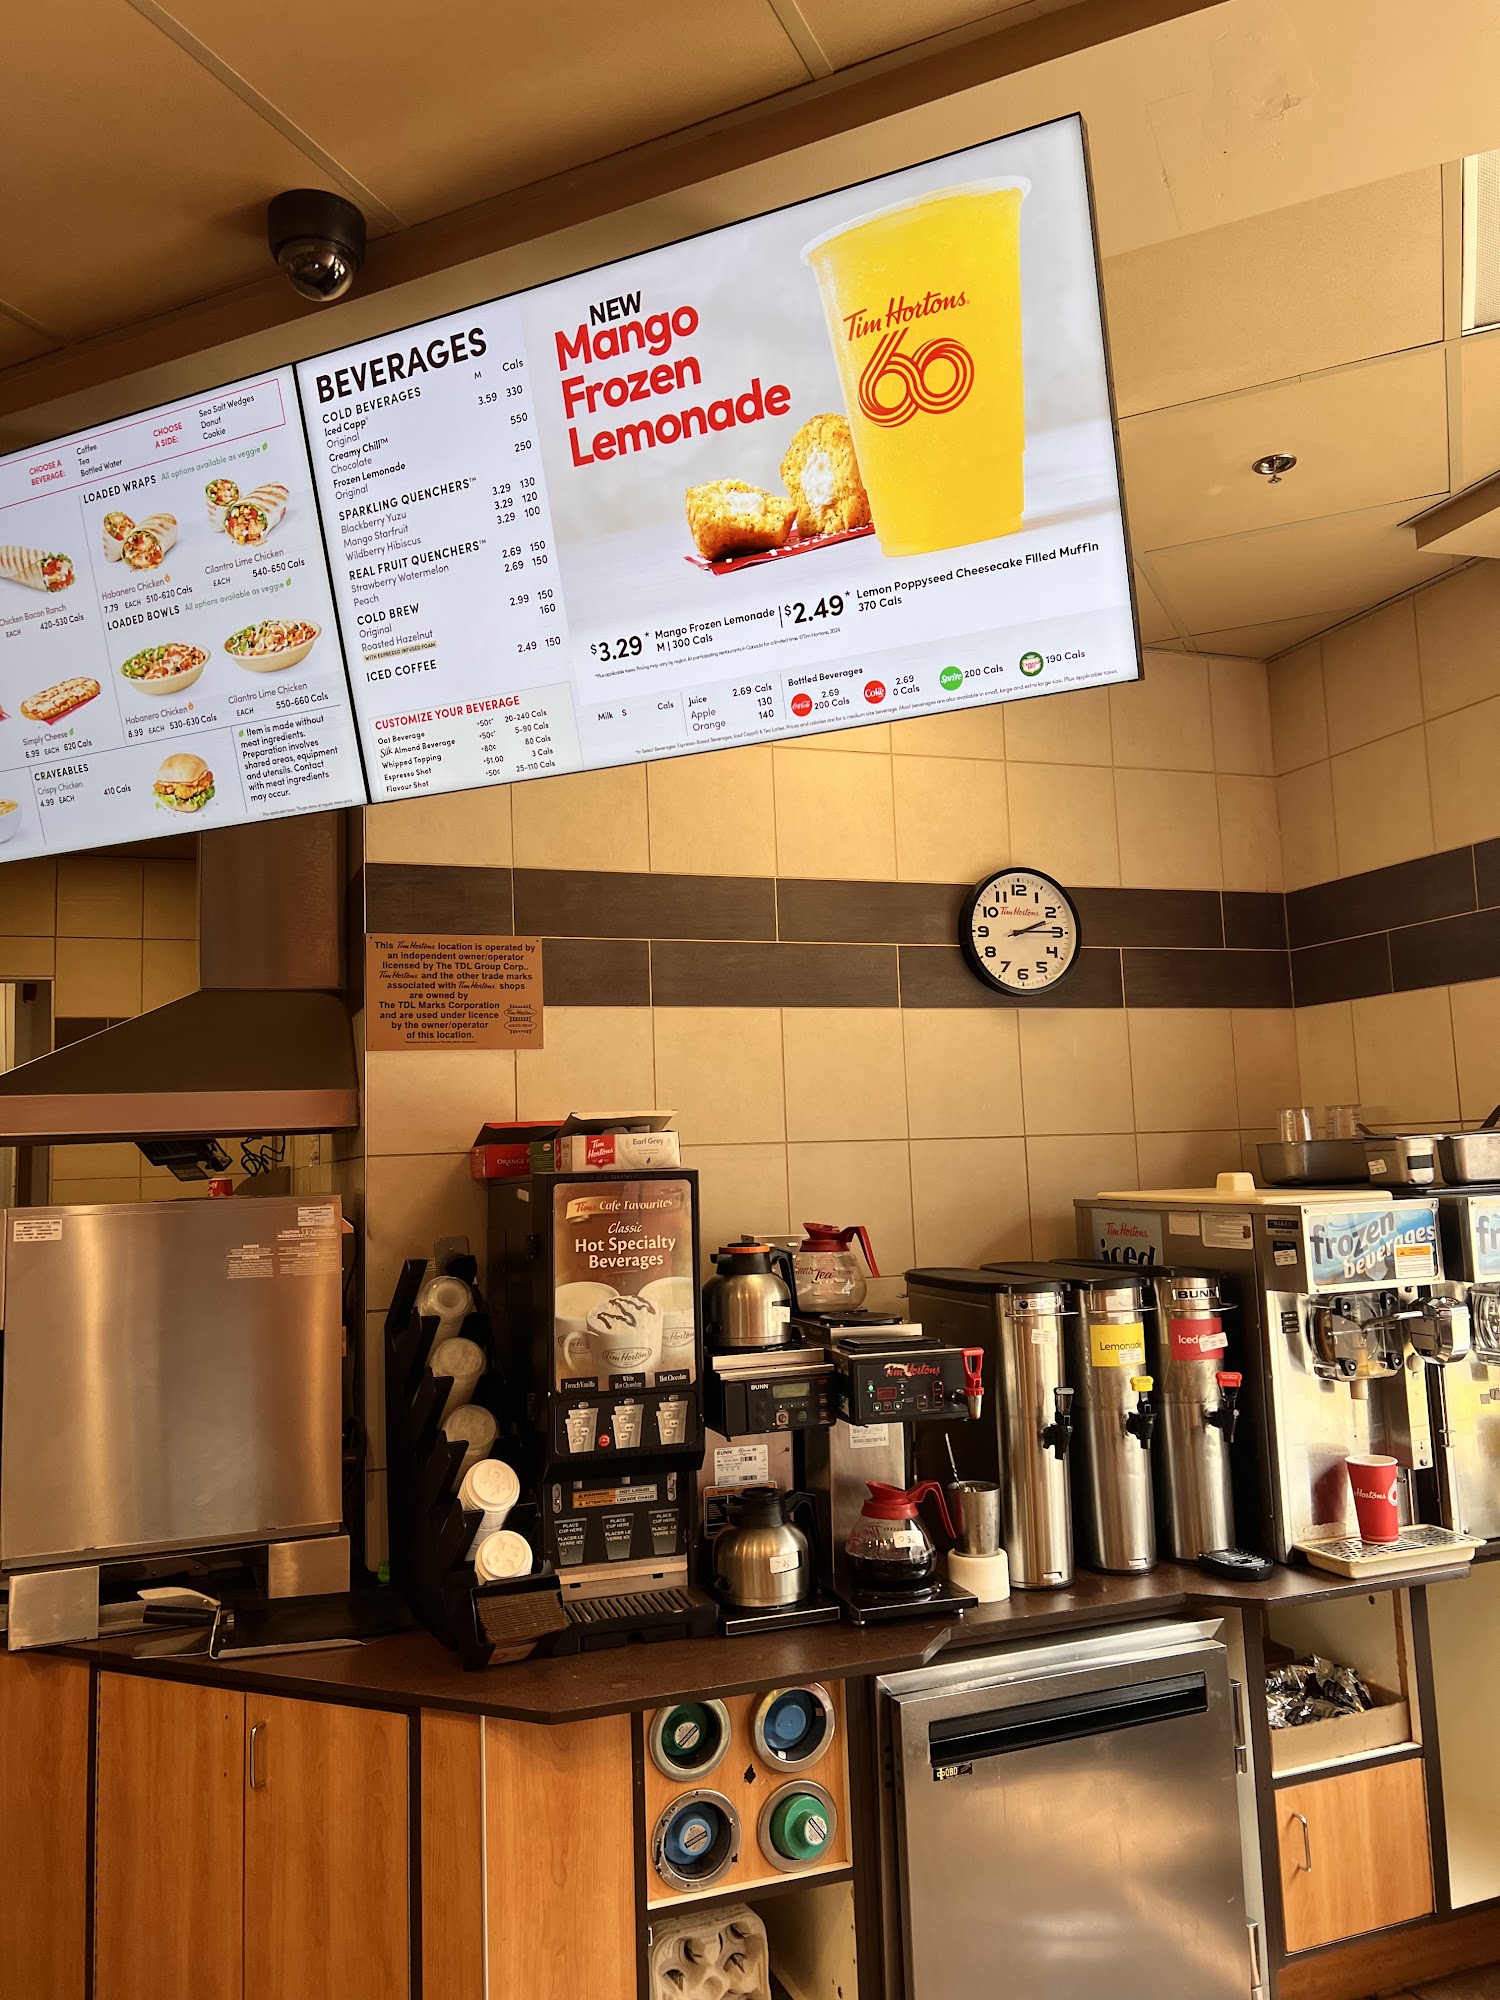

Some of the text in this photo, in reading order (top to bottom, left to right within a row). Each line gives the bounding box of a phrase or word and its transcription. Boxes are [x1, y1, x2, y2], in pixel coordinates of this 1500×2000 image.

[589, 290, 641, 327] NEW
[843, 308, 882, 342] Tim
[554, 305, 699, 372] Mango
[315, 327, 487, 404] BEVERAGES
[857, 326, 975, 429] 60
[506, 384, 523, 398] 330
[562, 356, 702, 420] Frozen
[322, 386, 421, 424] COLD BEVERAGES
[477, 392, 498, 406] 3.59
[198, 395, 255, 418] Sea Salt Wedges
[510, 412, 528, 425] 550
[568, 379, 791, 468] Lemonade
[152, 421, 183, 438] CHOOSE
[324, 423, 343, 437] Iced
[155, 435, 179, 449] A SIDE:
[514, 439, 532, 453] 250
[328, 448, 361, 462] Creamy
[29, 459, 63, 476] CHOOSE A
[80, 459, 123, 477] Bottled Water
[31, 469, 66, 486] BEVERAGE:
[333, 461, 406, 489] Frozen Lemonade
[83, 474, 157, 504] LOADED WRAPS
[338, 497, 398, 521] SPARKLING
[340, 511, 407, 535] Blackberry Yuzu
[348, 565, 376, 581] REAL
[377, 557, 408, 574] FRUIT
[856, 542, 1099, 599] Lemon Poppyseed Cheesecake Filled Muffin
[351, 564, 450, 594] Strawberry Watermelon
[101, 579, 165, 601] Habanero Chicken
[103, 585, 193, 614] 7.79 EACH 510-620 Cals
[858, 595, 903, 612] 370 Cals
[107, 604, 180, 631] LOADED BOWLS
[356, 602, 419, 626] COLD BREW
[654, 608, 775, 640] Mango Frozen Lemonade
[656, 633, 713, 652] M 300 Cals
[1045, 649, 1086, 664] 190 Cals
[366, 659, 437, 683] ICED COFFEE
[787, 668, 864, 687] Bottled Beverages
[964, 664, 1004, 679] 200 Cals
[940, 673, 963, 684] Sprite
[227, 682, 308, 705] Cilantro Lime Chicken
[732, 683, 773, 697] 2.69 Cals
[275, 691, 329, 710] 550-660 Cals
[688, 695, 707, 708] Juice
[757, 696, 773, 707] 130
[375, 695, 520, 731] CUSTOMIZE YOUR BEVERAGE
[504, 708, 547, 723] 20-240 Cals
[690, 707, 716, 721] Apple
[758, 709, 774, 720] 140
[692, 720, 726, 732] Orange
[34, 763, 89, 782] CRAVEABLES
[996, 891, 1007, 903] 11
[1011, 884, 1027, 896] 12
[1034, 892, 1039, 904] 1
[983, 906, 999, 918] 10
[1044, 906, 1057, 918] 2
[977, 925, 990, 938] 9
[1052, 926, 1064, 938] 3
[374, 941, 394, 950] This
[437, 942, 473, 951] location
[474, 942, 483, 951] is
[484, 943, 523, 953] operated
[525, 944, 536, 953] by
[984, 946, 996, 958] 8
[1046, 946, 1058, 958] 4
[387, 951, 524, 963] an independent owner/operator
[382, 961, 421, 970] licensed
[422, 961, 434, 972] by
[435, 961, 453, 970] The
[454, 961, 473, 970] TDL
[474, 962, 501, 972] Group
[1000, 961, 1011, 973] 7
[1035, 961, 1048, 973] 5
[1017, 968, 1029, 980] 6
[591, 1138, 605, 1149] Tim
[647, 1137, 664, 1146] Grey
[588, 1147, 613, 1159] Hortons
[497, 1158, 525, 1166] ORANGE
[599, 1199, 622, 1212] Café
[623, 1198, 673, 1211] Favourites
[608, 1221, 643, 1235] Classic
[1106, 1222, 1119, 1235] Tim
[575, 1234, 676, 1255] Hot Specialty
[1310, 1211, 1395, 1265] frozen
[589, 1254, 664, 1269] Beverages
[1177, 1289, 1218, 1299] BUNN
[1099, 1340, 1143, 1352] Lemonade
[1178, 1334, 1199, 1344] Iced
